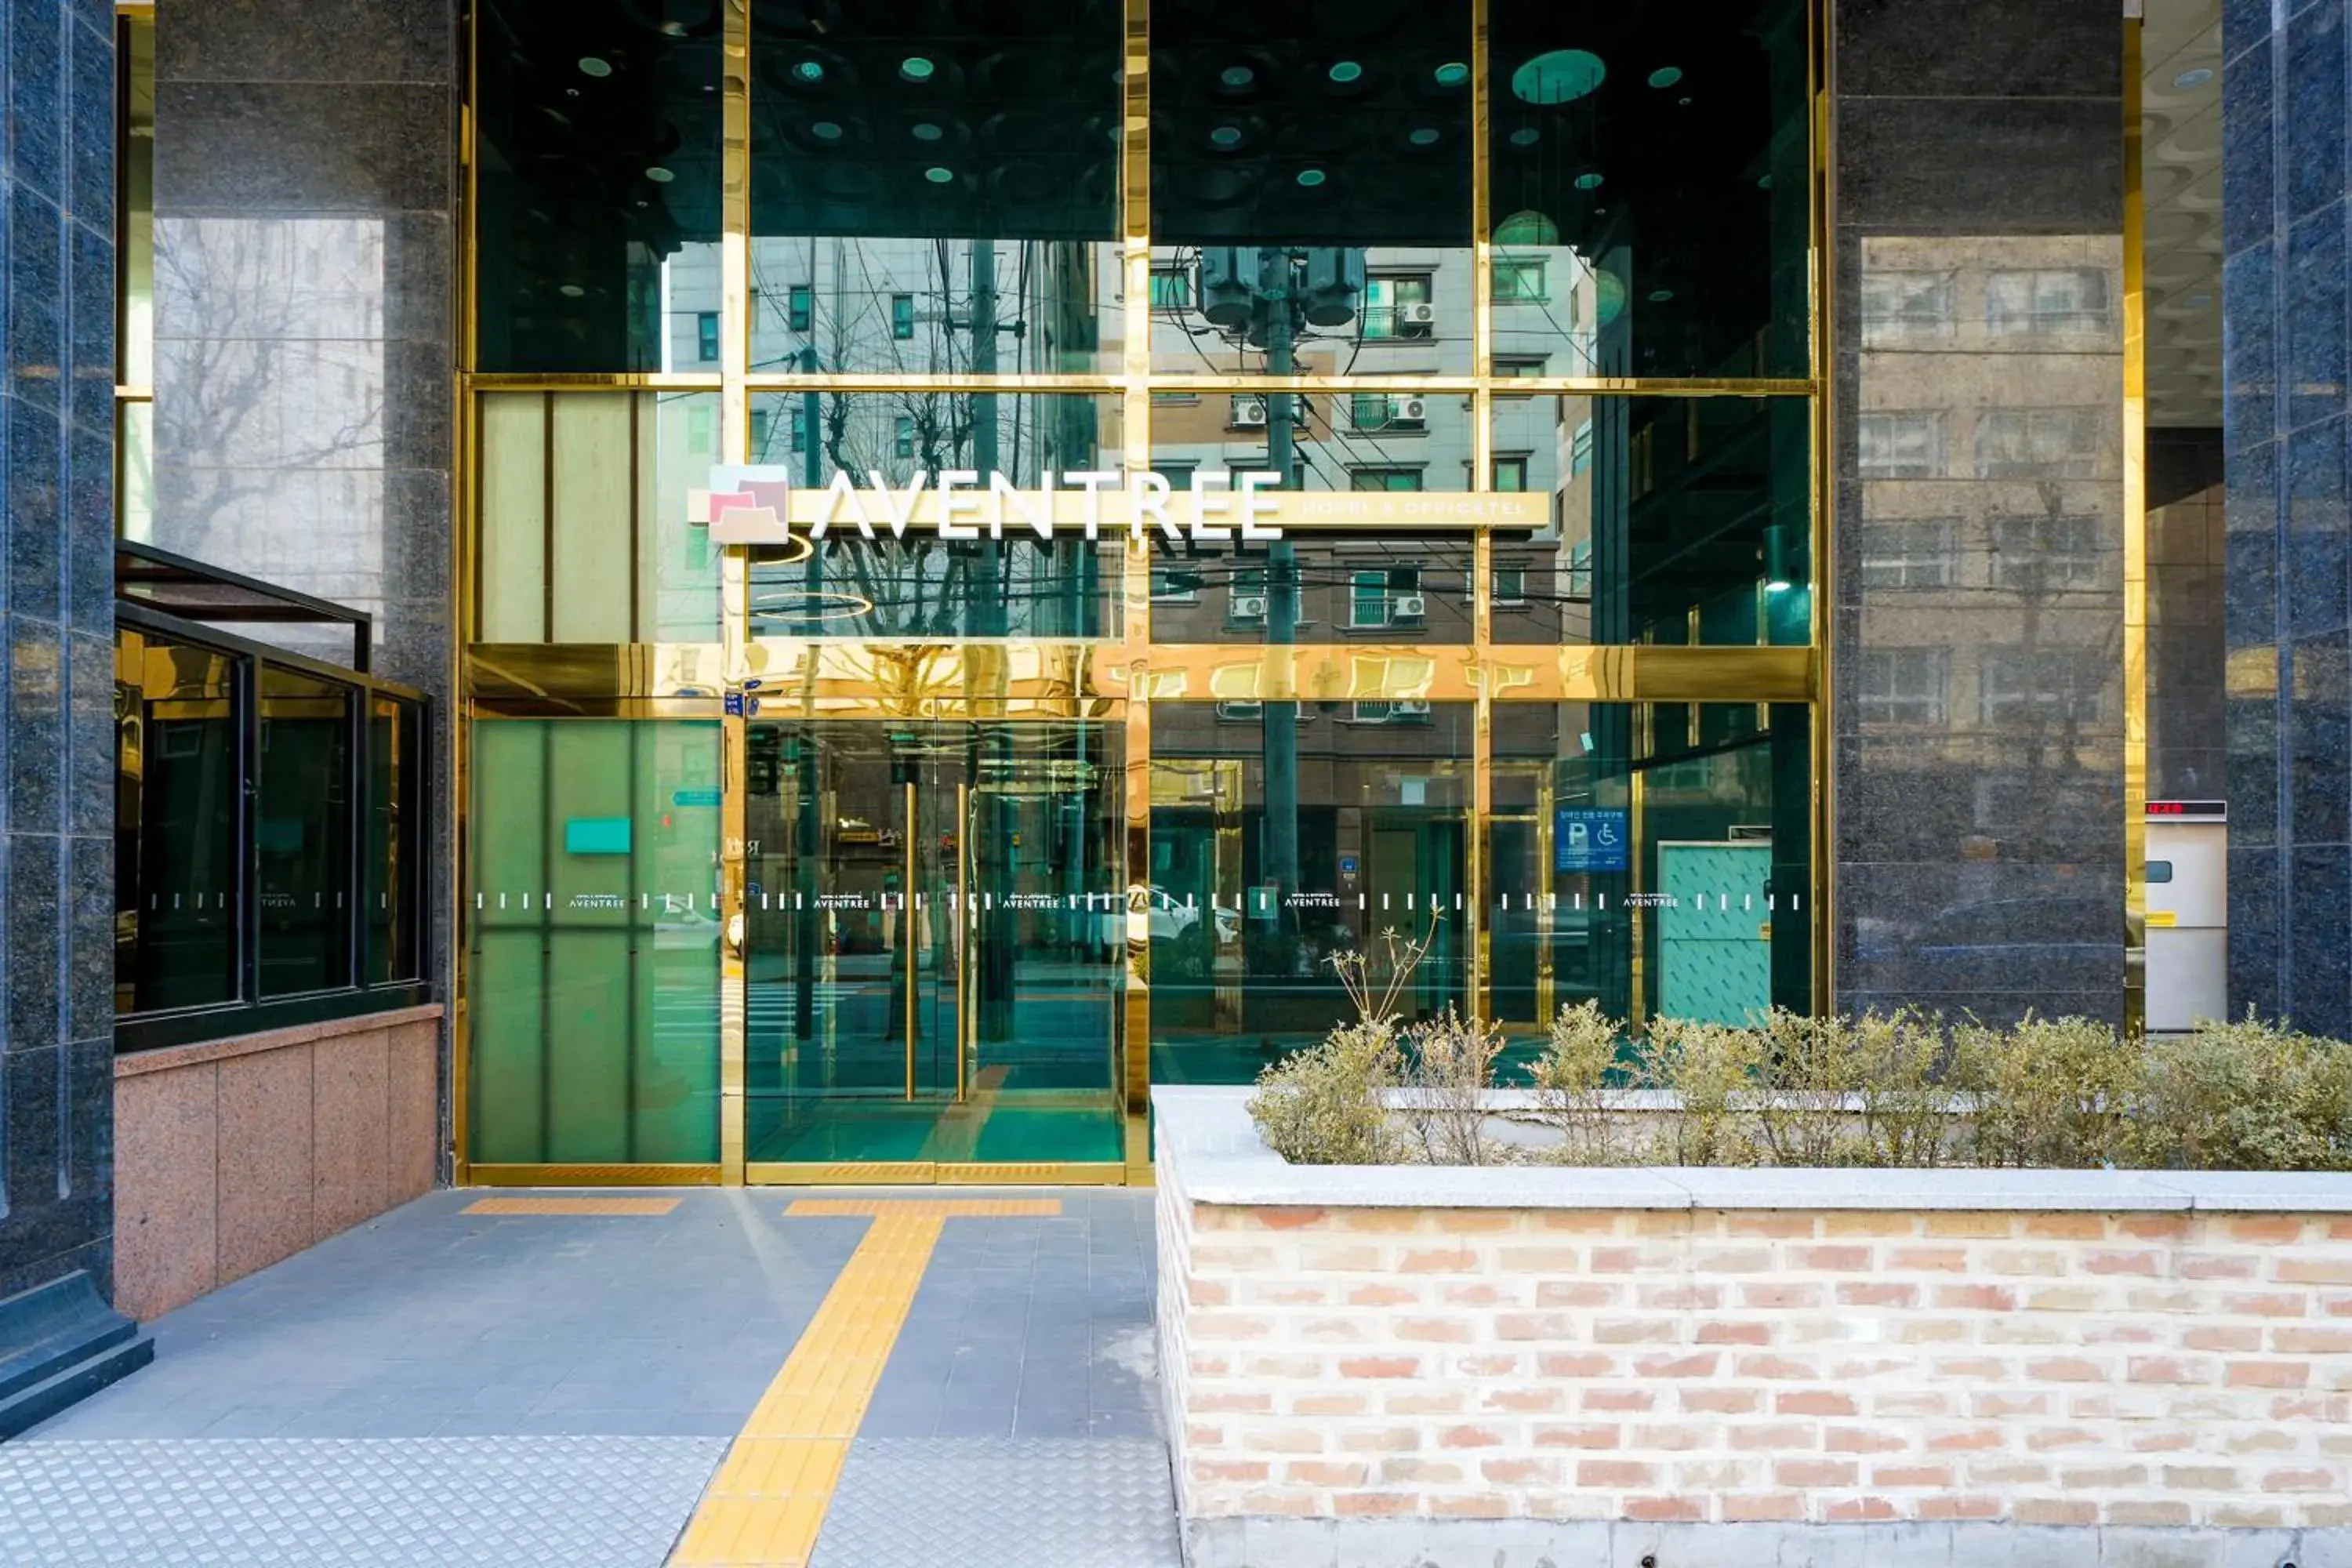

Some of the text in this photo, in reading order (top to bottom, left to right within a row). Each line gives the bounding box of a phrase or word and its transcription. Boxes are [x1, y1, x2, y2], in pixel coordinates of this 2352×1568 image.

[809, 470, 1283, 540] AVENTREE
[1569, 822, 1588, 845] P
[569, 899, 625, 908] AVENTREE
[814, 899, 869, 908] AVENTREE
[1003, 899, 1059, 908] AVENTREE
[1285, 898, 1340, 907] AVENTREE
[1623, 898, 1679, 907] AVENTREE
